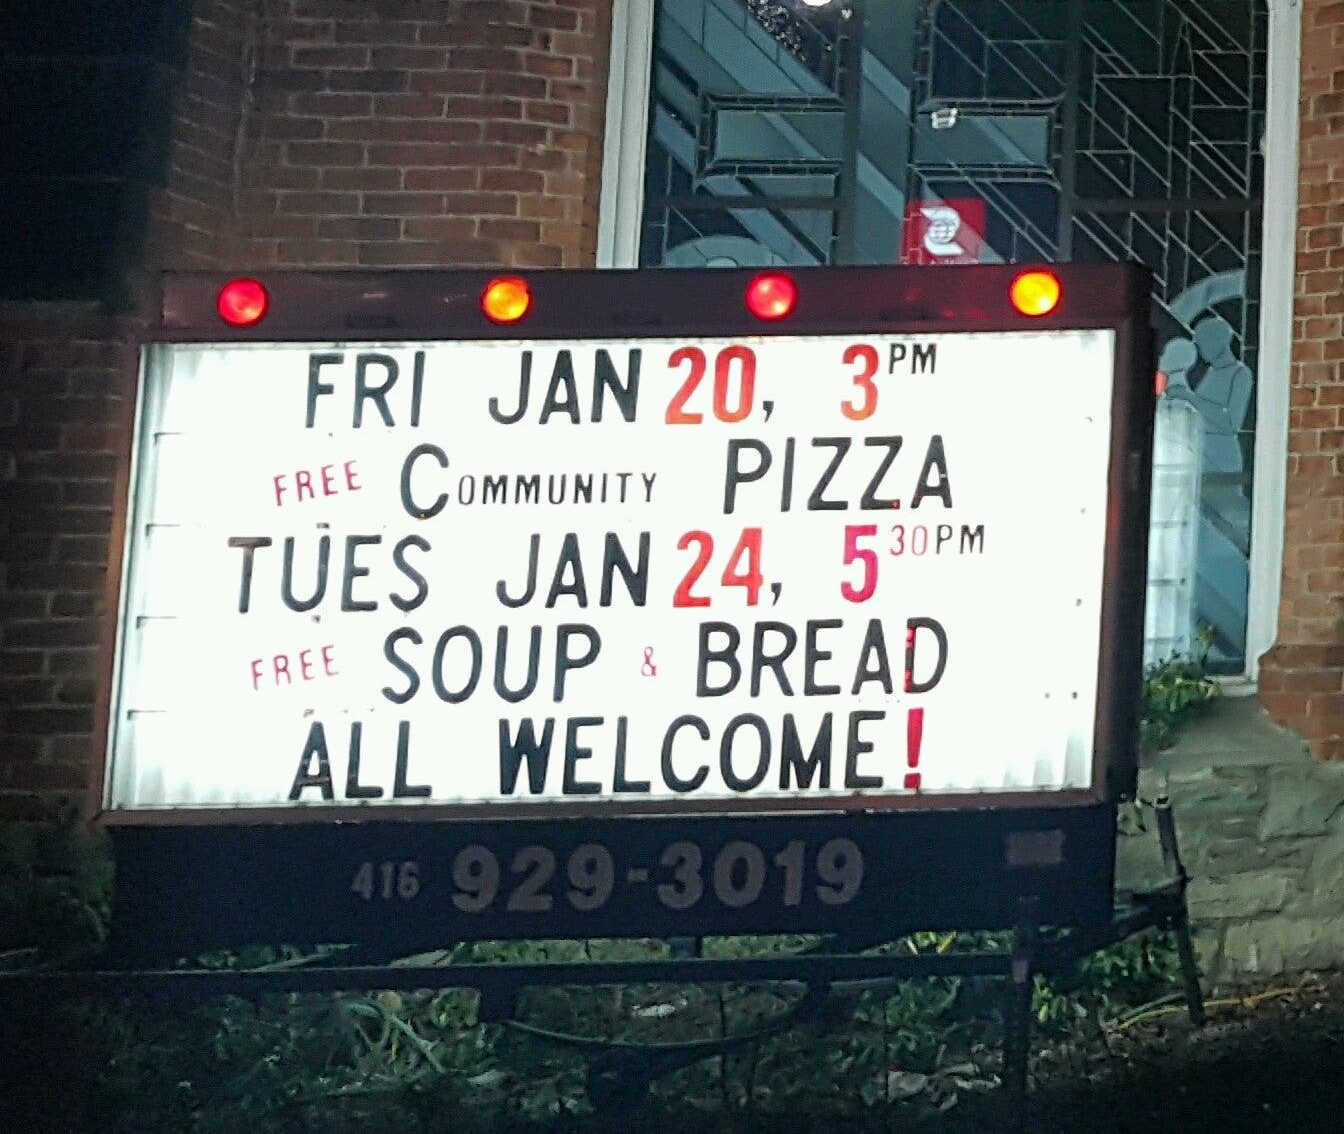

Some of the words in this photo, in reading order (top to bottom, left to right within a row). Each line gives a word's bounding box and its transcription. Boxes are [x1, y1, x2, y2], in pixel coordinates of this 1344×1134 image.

[306, 350, 425, 428] FRI
[489, 348, 642, 425] JAN
[665, 344, 774, 424] 20,
[273, 460, 363, 506] FREE
[723, 435, 952, 514] PIZZA
[228, 535, 431, 614] TUES
[496, 531, 650, 608] JAN
[673, 528, 782, 608] 24,
[250, 645, 340, 691] FREE
[382, 623, 601, 704] SOUP
[641, 645, 657, 677] &
[696, 617, 948, 698] BREAD
[288, 721, 432, 800] ALL
[499, 707, 925, 794] WELCOME!
[351, 860, 421, 900] 416
[450, 837, 864, 913] 929-3019
